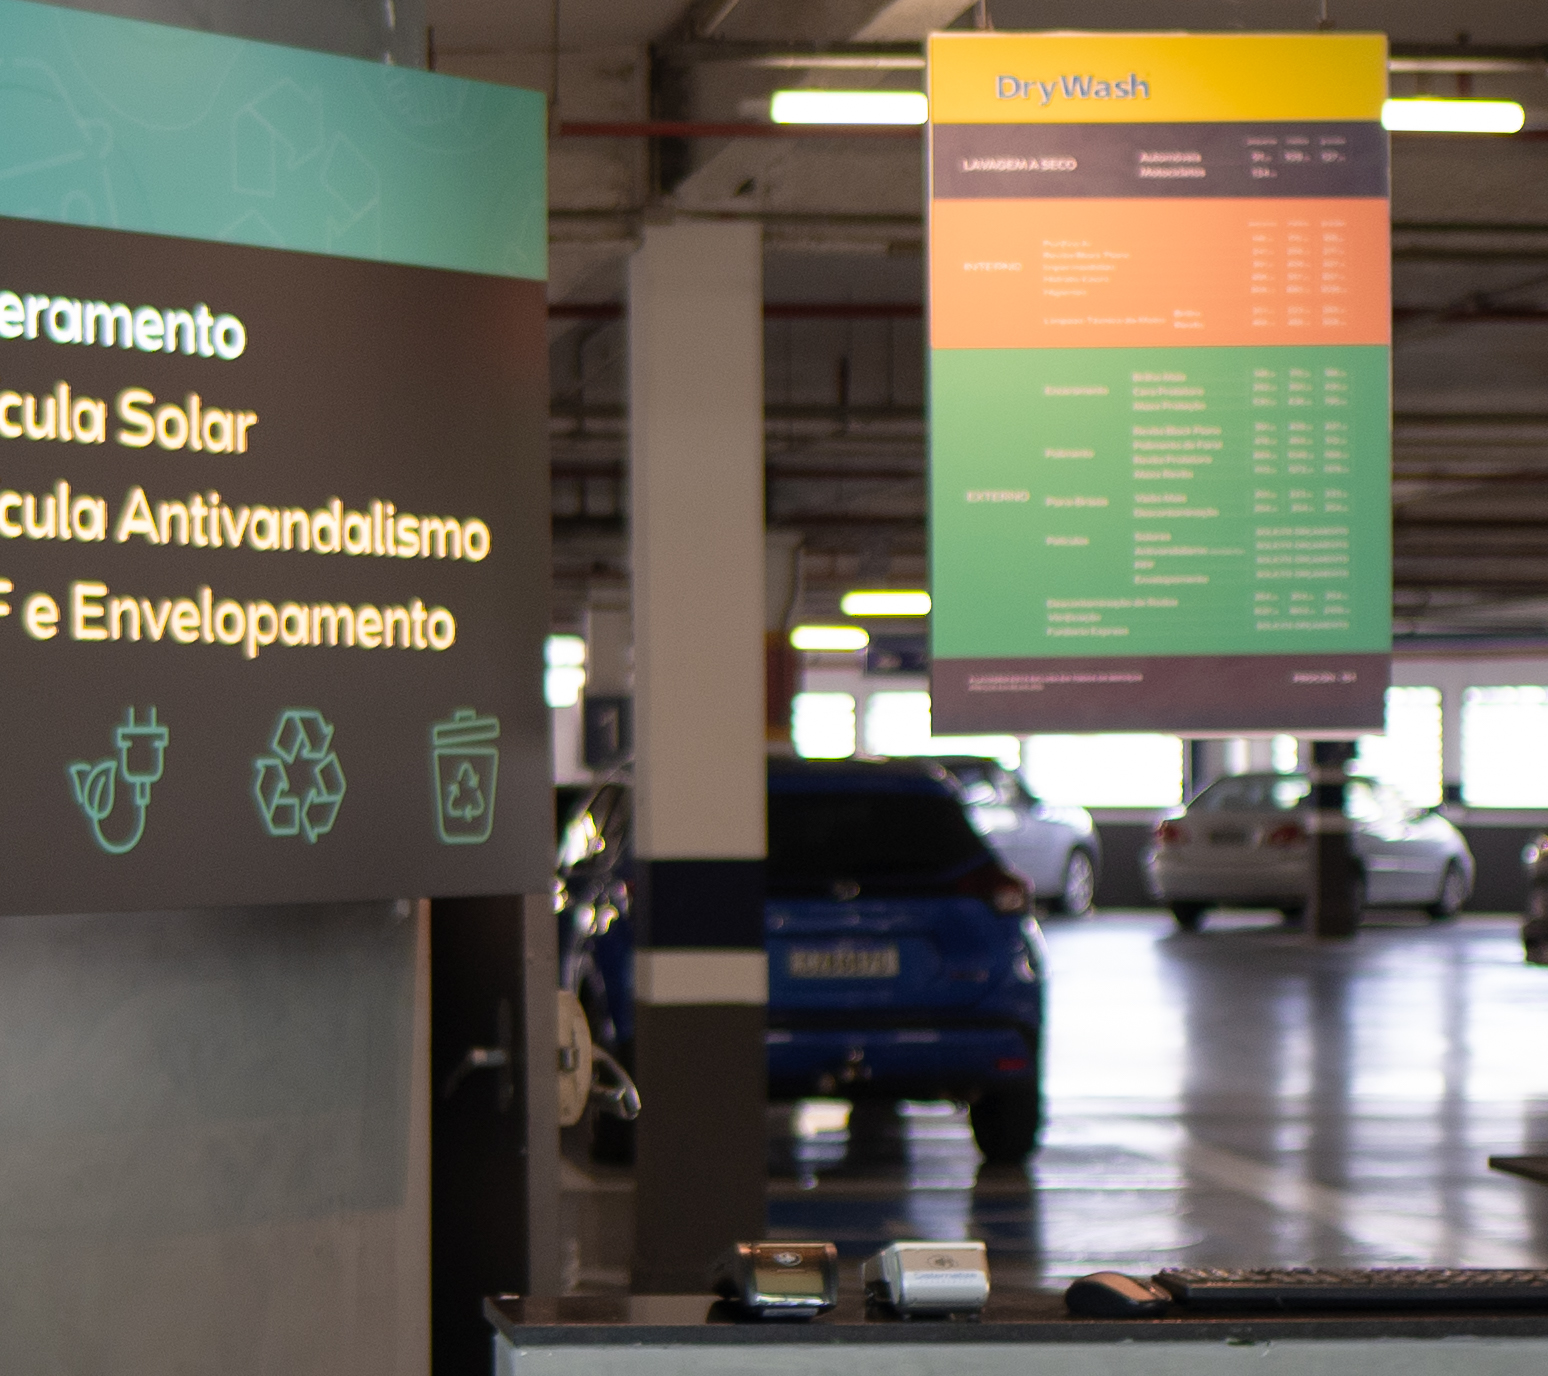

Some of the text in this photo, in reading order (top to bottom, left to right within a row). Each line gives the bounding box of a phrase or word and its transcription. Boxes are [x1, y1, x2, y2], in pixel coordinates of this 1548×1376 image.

[117, 389, 259, 454] Solar
[116, 487, 492, 562] Antivandalismo
[24, 594, 61, 641] e
[71, 581, 457, 659] Envelopamento
